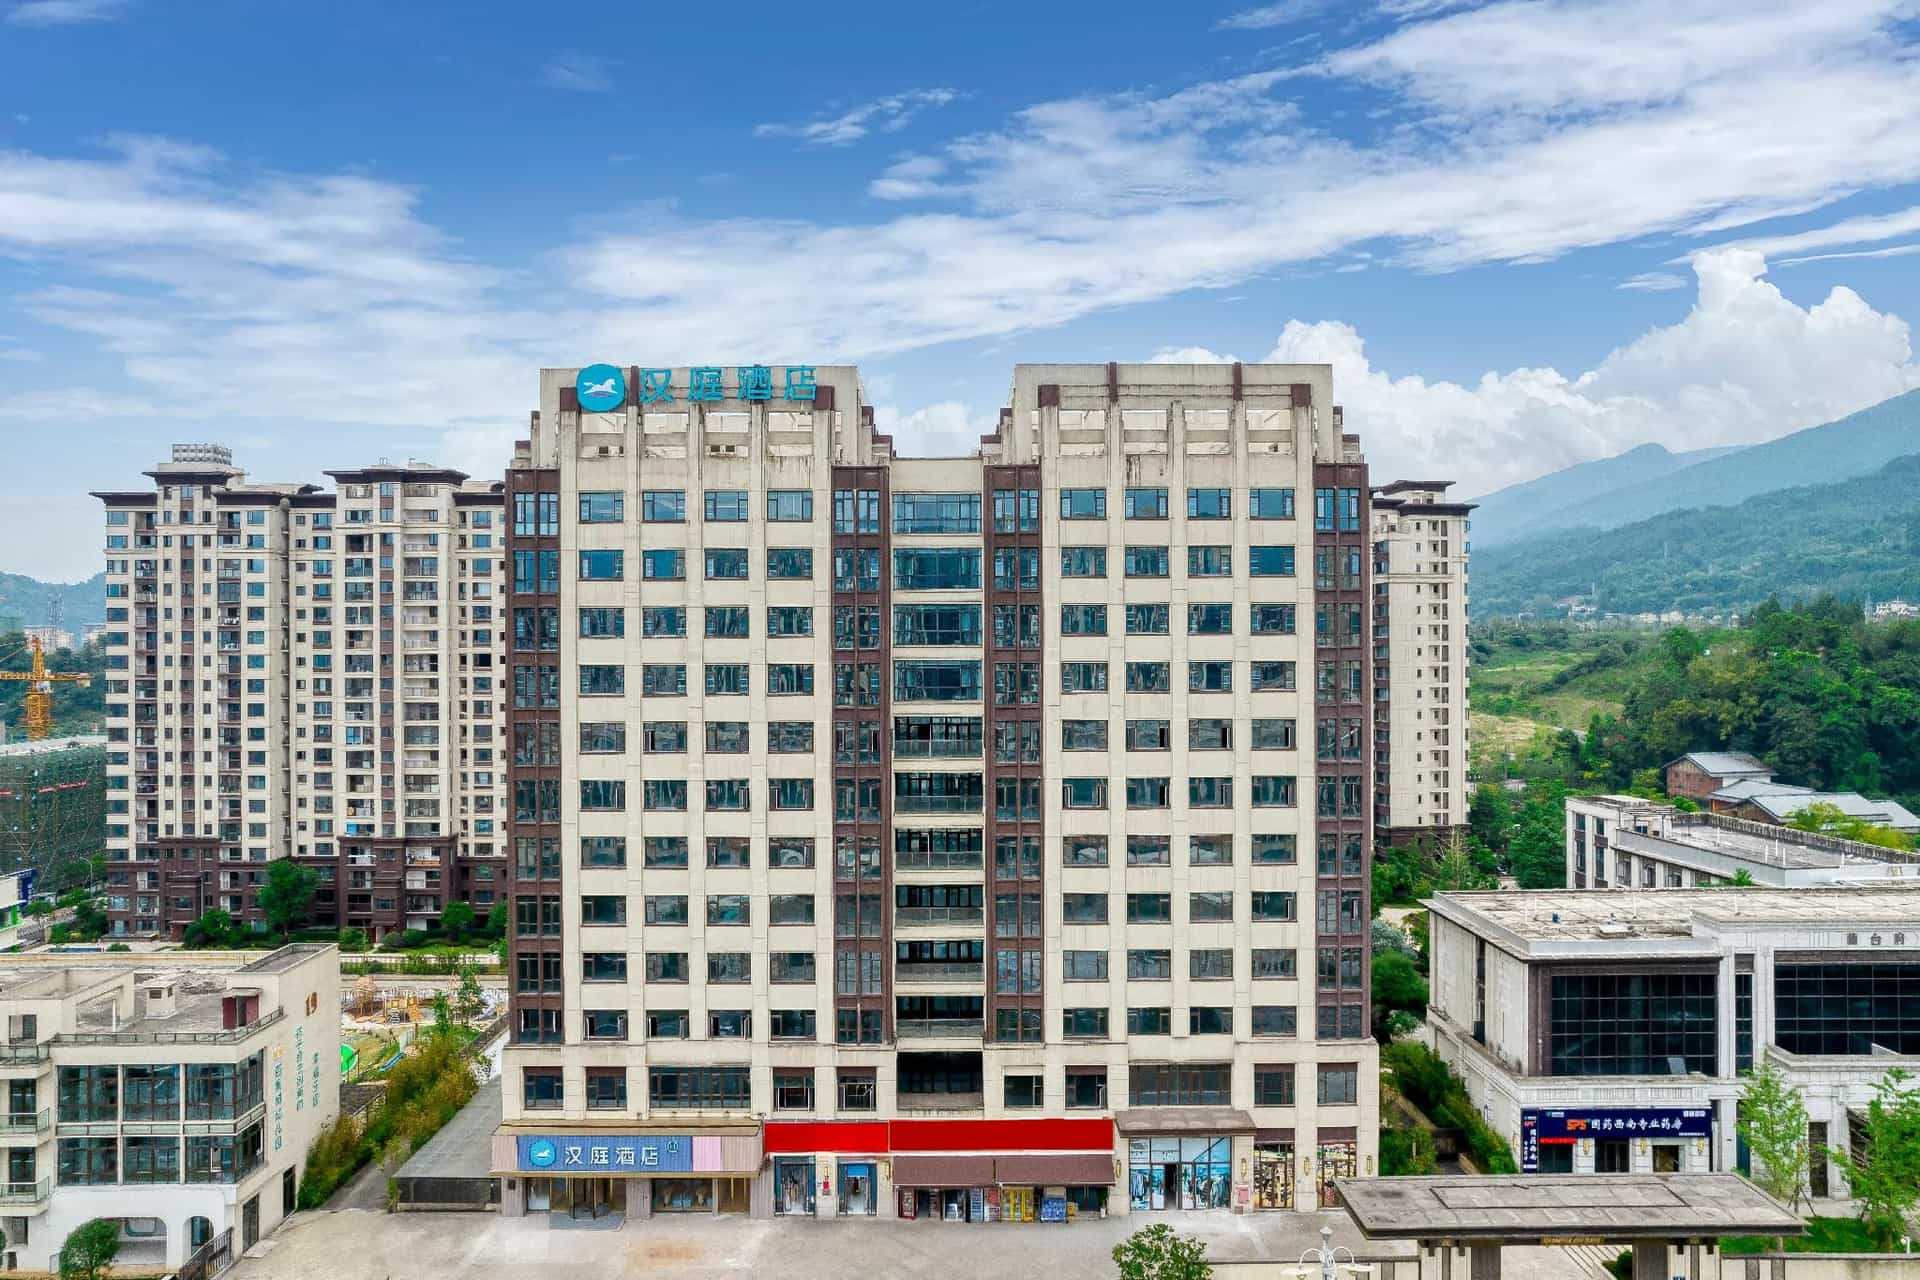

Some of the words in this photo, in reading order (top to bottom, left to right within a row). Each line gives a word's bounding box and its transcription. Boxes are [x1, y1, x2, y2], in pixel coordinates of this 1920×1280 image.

[639, 365, 817, 402] 汉庭酒店
[1591, 1117, 1683, 1131] 国药西南专业药房
[564, 1146, 658, 1166] 汉庭酒店
